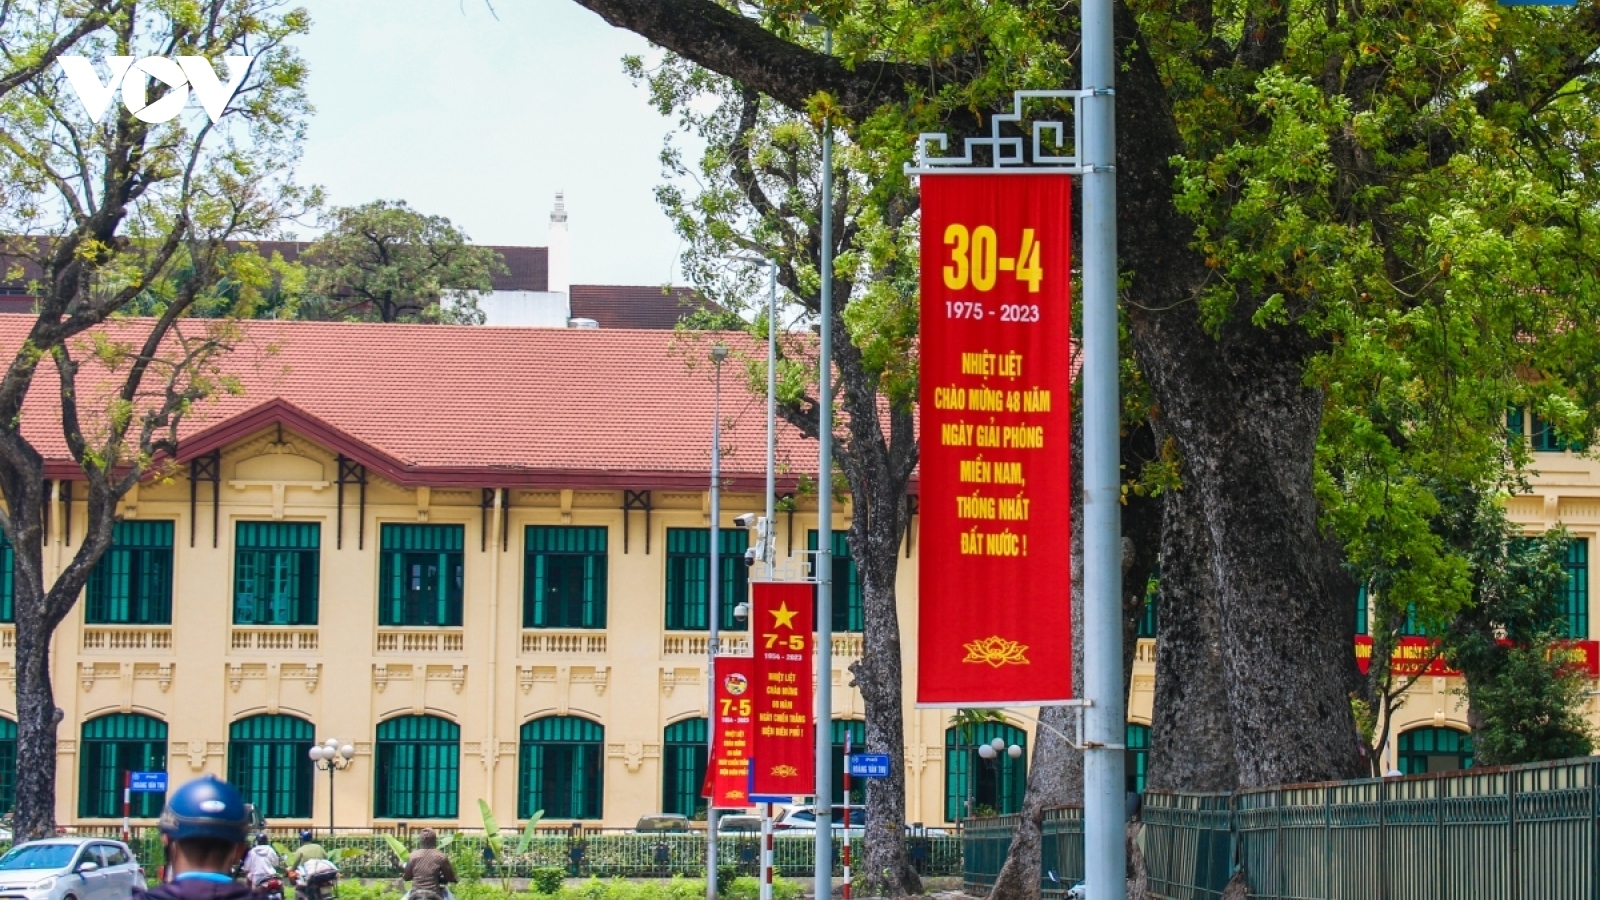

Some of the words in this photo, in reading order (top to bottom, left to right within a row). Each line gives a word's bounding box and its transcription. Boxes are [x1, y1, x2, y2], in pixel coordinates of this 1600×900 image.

[943, 223, 1043, 293] 30-4
[946, 301, 983, 320] 1975
[1000, 304, 1040, 322] 2023
[962, 349, 996, 380] NHIỆT
[999, 350, 1023, 381] LIỆT
[935, 383, 965, 410] CHÀO
[968, 384, 1003, 411] MỪNG
[1006, 390, 1020, 412] 48
[1024, 385, 1050, 412] NĂM
[942, 419, 973, 446] NGÀY
[976, 416, 1000, 448] GIẢI
[1003, 422, 1043, 448] PHÓNG
[960, 453, 991, 483] MIỀN
[994, 461, 1025, 487] NAM,
[956, 489, 995, 520] THỐNG
[999, 490, 1029, 520] NHẤT
[960, 525, 984, 554] ĐẤT
[987, 528, 1019, 556] NƯỚC
[762, 633, 804, 650] 7-5
[1355, 642, 1373, 658] ỪNG
[785, 672, 796, 684] LIỆT
[720, 698, 751, 716] 7-5
